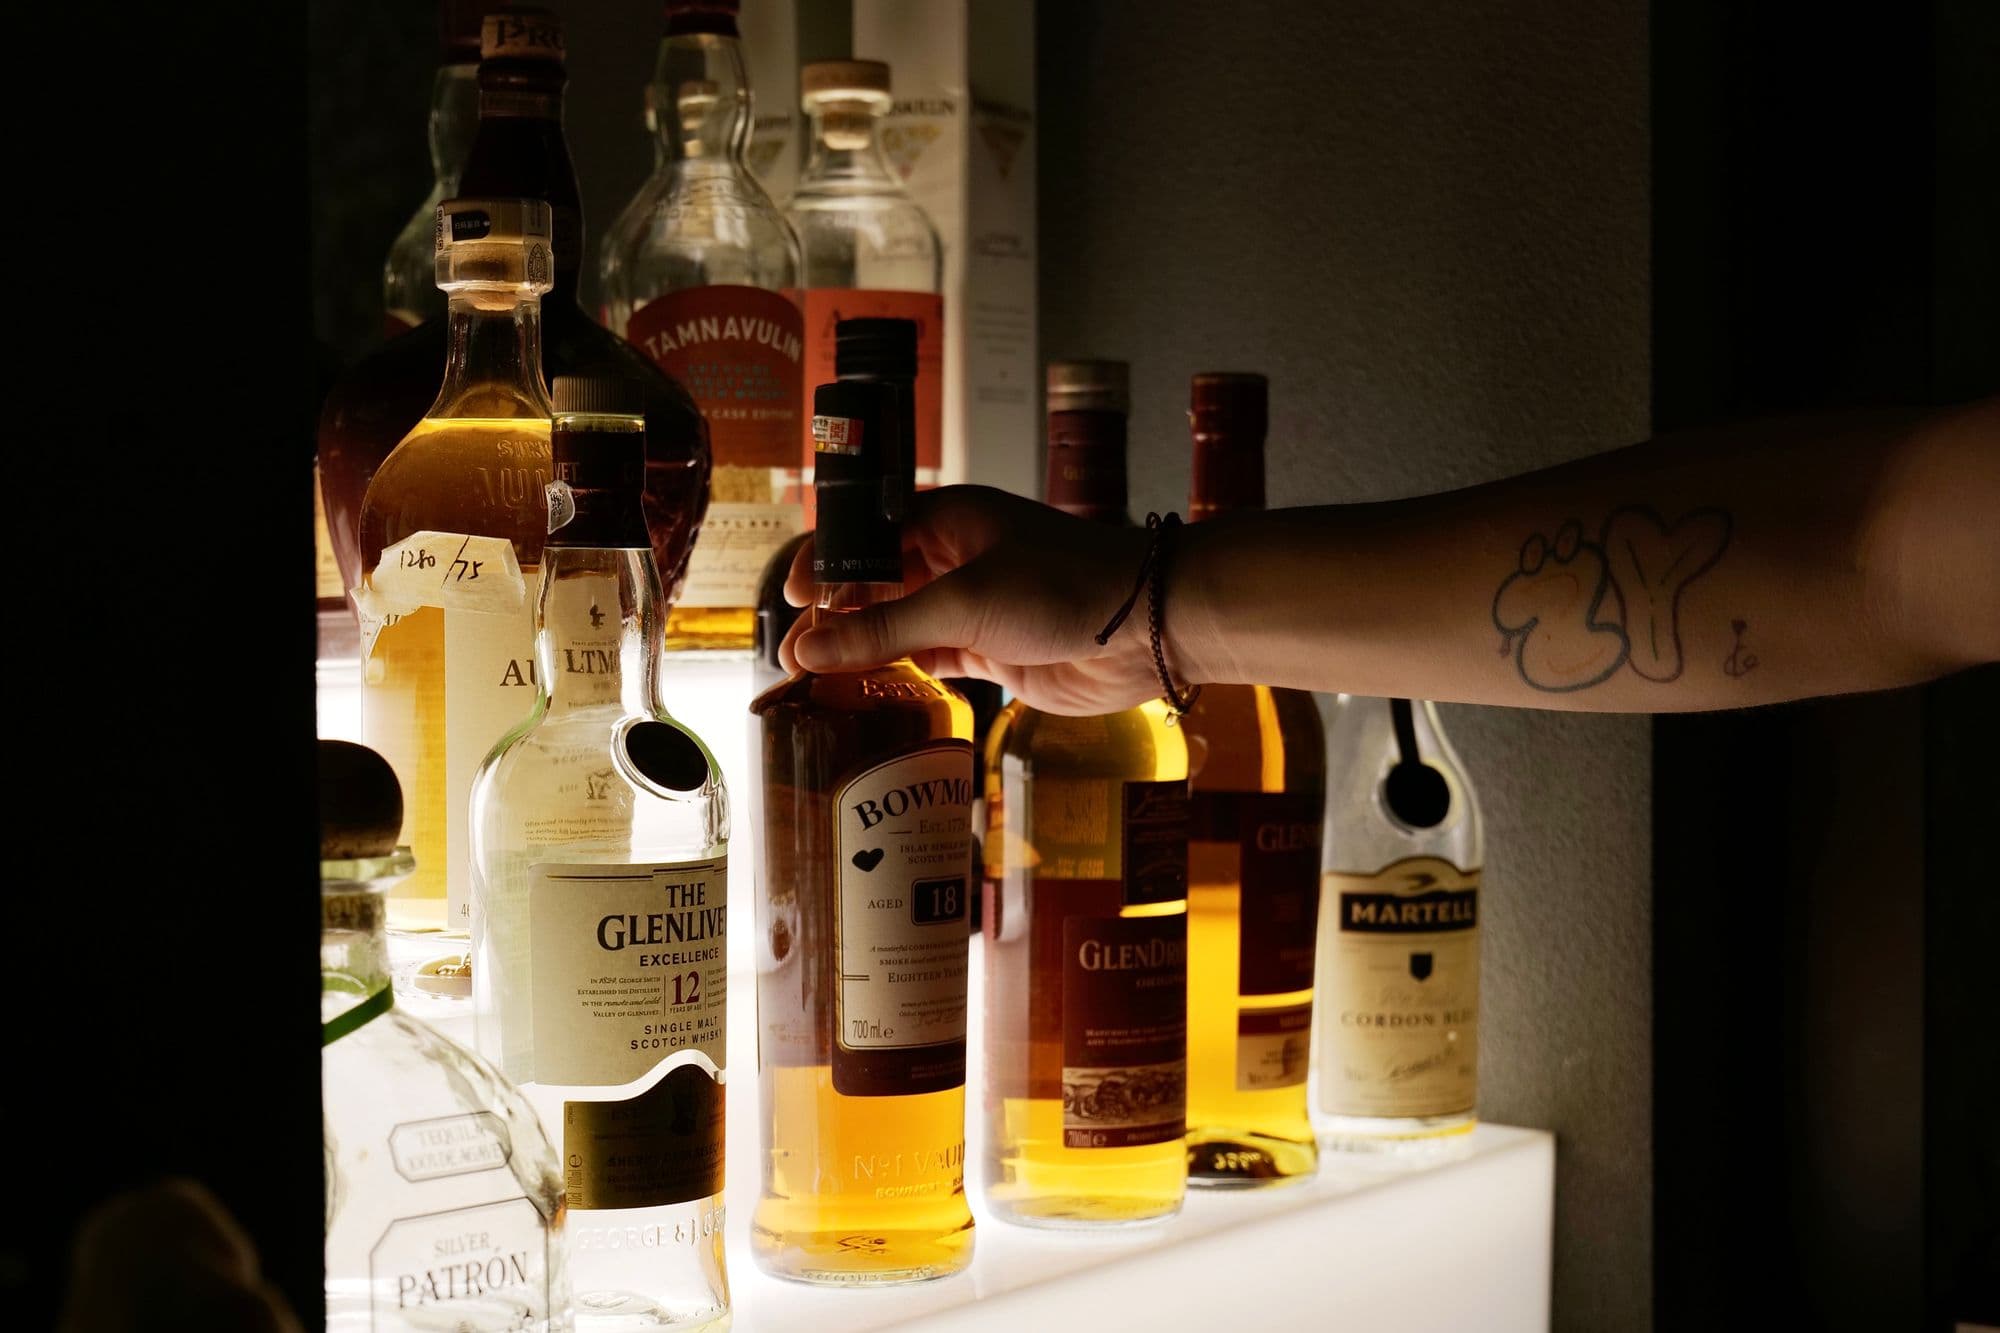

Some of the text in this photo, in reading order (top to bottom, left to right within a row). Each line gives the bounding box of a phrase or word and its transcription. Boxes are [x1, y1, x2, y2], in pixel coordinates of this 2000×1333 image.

[643, 316, 802, 365] TAMNAVULIN
[665, 882, 706, 909] THE
[867, 885, 957, 916] AGED 18
[1350, 897, 1472, 925] MARTELL
[639, 947, 719, 967] EXCELLENCE
[888, 971, 941, 983] EIGHTEEN
[629, 987, 660, 995] DISTILLERY
[671, 970, 701, 1006] 12
[644, 1015, 718, 1035] SINGLE MALT
[1341, 1011, 1434, 1027] CORDON
[852, 1020, 869, 1039] 700
[630, 1036, 686, 1050] SCOTCH
[433, 1231, 491, 1258] SILVER
